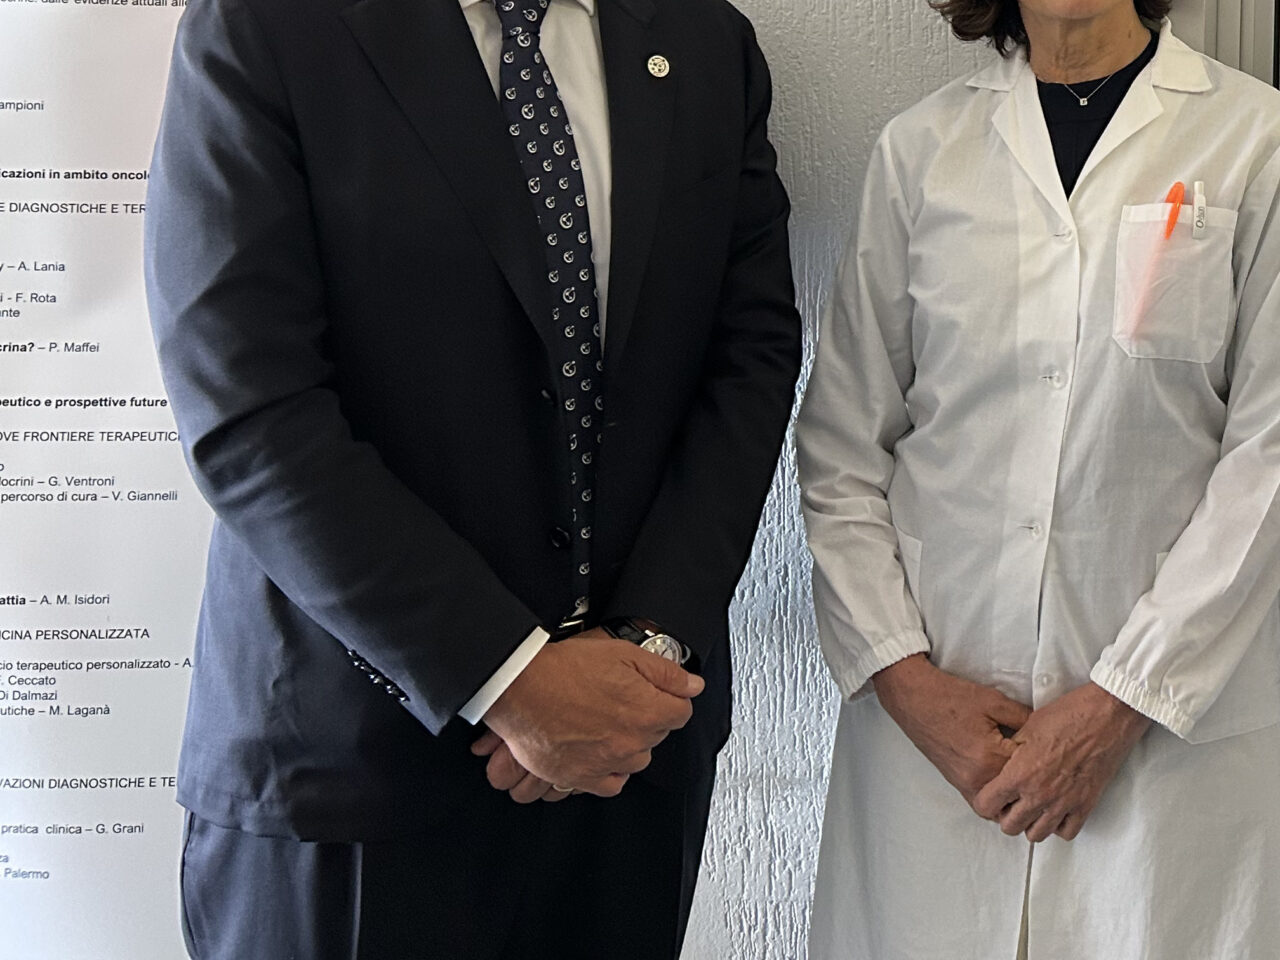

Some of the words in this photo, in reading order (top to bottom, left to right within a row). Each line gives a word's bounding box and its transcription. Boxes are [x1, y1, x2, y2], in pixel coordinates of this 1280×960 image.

[49, 169, 60, 179] in
[63, 169, 108, 180] ambito
[9, 202, 107, 214] DIAGNOSTICHE
[110, 203, 119, 214] E
[33, 261, 66, 272] Lania
[15, 293, 26, 303] F.
[30, 292, 57, 303] Rota
[49, 342, 60, 353] P.
[63, 342, 100, 353] Maffei
[44, 399, 52, 407] e
[55, 396, 127, 410] prospettive
[130, 396, 168, 408] future
[23, 431, 94, 442] FRONTIERE
[99, 431, 180, 442] TERAPEUTIC
[48, 476, 61, 487] G.
[64, 476, 115, 487] Ventroni
[1, 492, 54, 504] percorso
[57, 491, 68, 502] di
[71, 493, 98, 502] cura
[112, 491, 123, 502] V.
[127, 490, 178, 502] Giannelli
[56, 594, 70, 605] M.
[74, 593, 110, 605] Isidori
[35, 628, 150, 641] PERSONALIZZATA
[16, 660, 83, 673] terapeutico
[86, 658, 171, 673] personalizzato
[8, 675, 57, 686] Ceccato
[12, 690, 58, 701] Dalmazi
[49, 705, 63, 716] M.
[67, 704, 110, 718] Laganà
[49, 776, 145, 789] DIAGNOSTICHE
[149, 776, 157, 788] E
[1, 824, 39, 836] pratica
[45, 823, 82, 835] clinica
[95, 823, 108, 834] G.
[112, 823, 144, 834] Grani
[4, 868, 50, 880] Palermo
